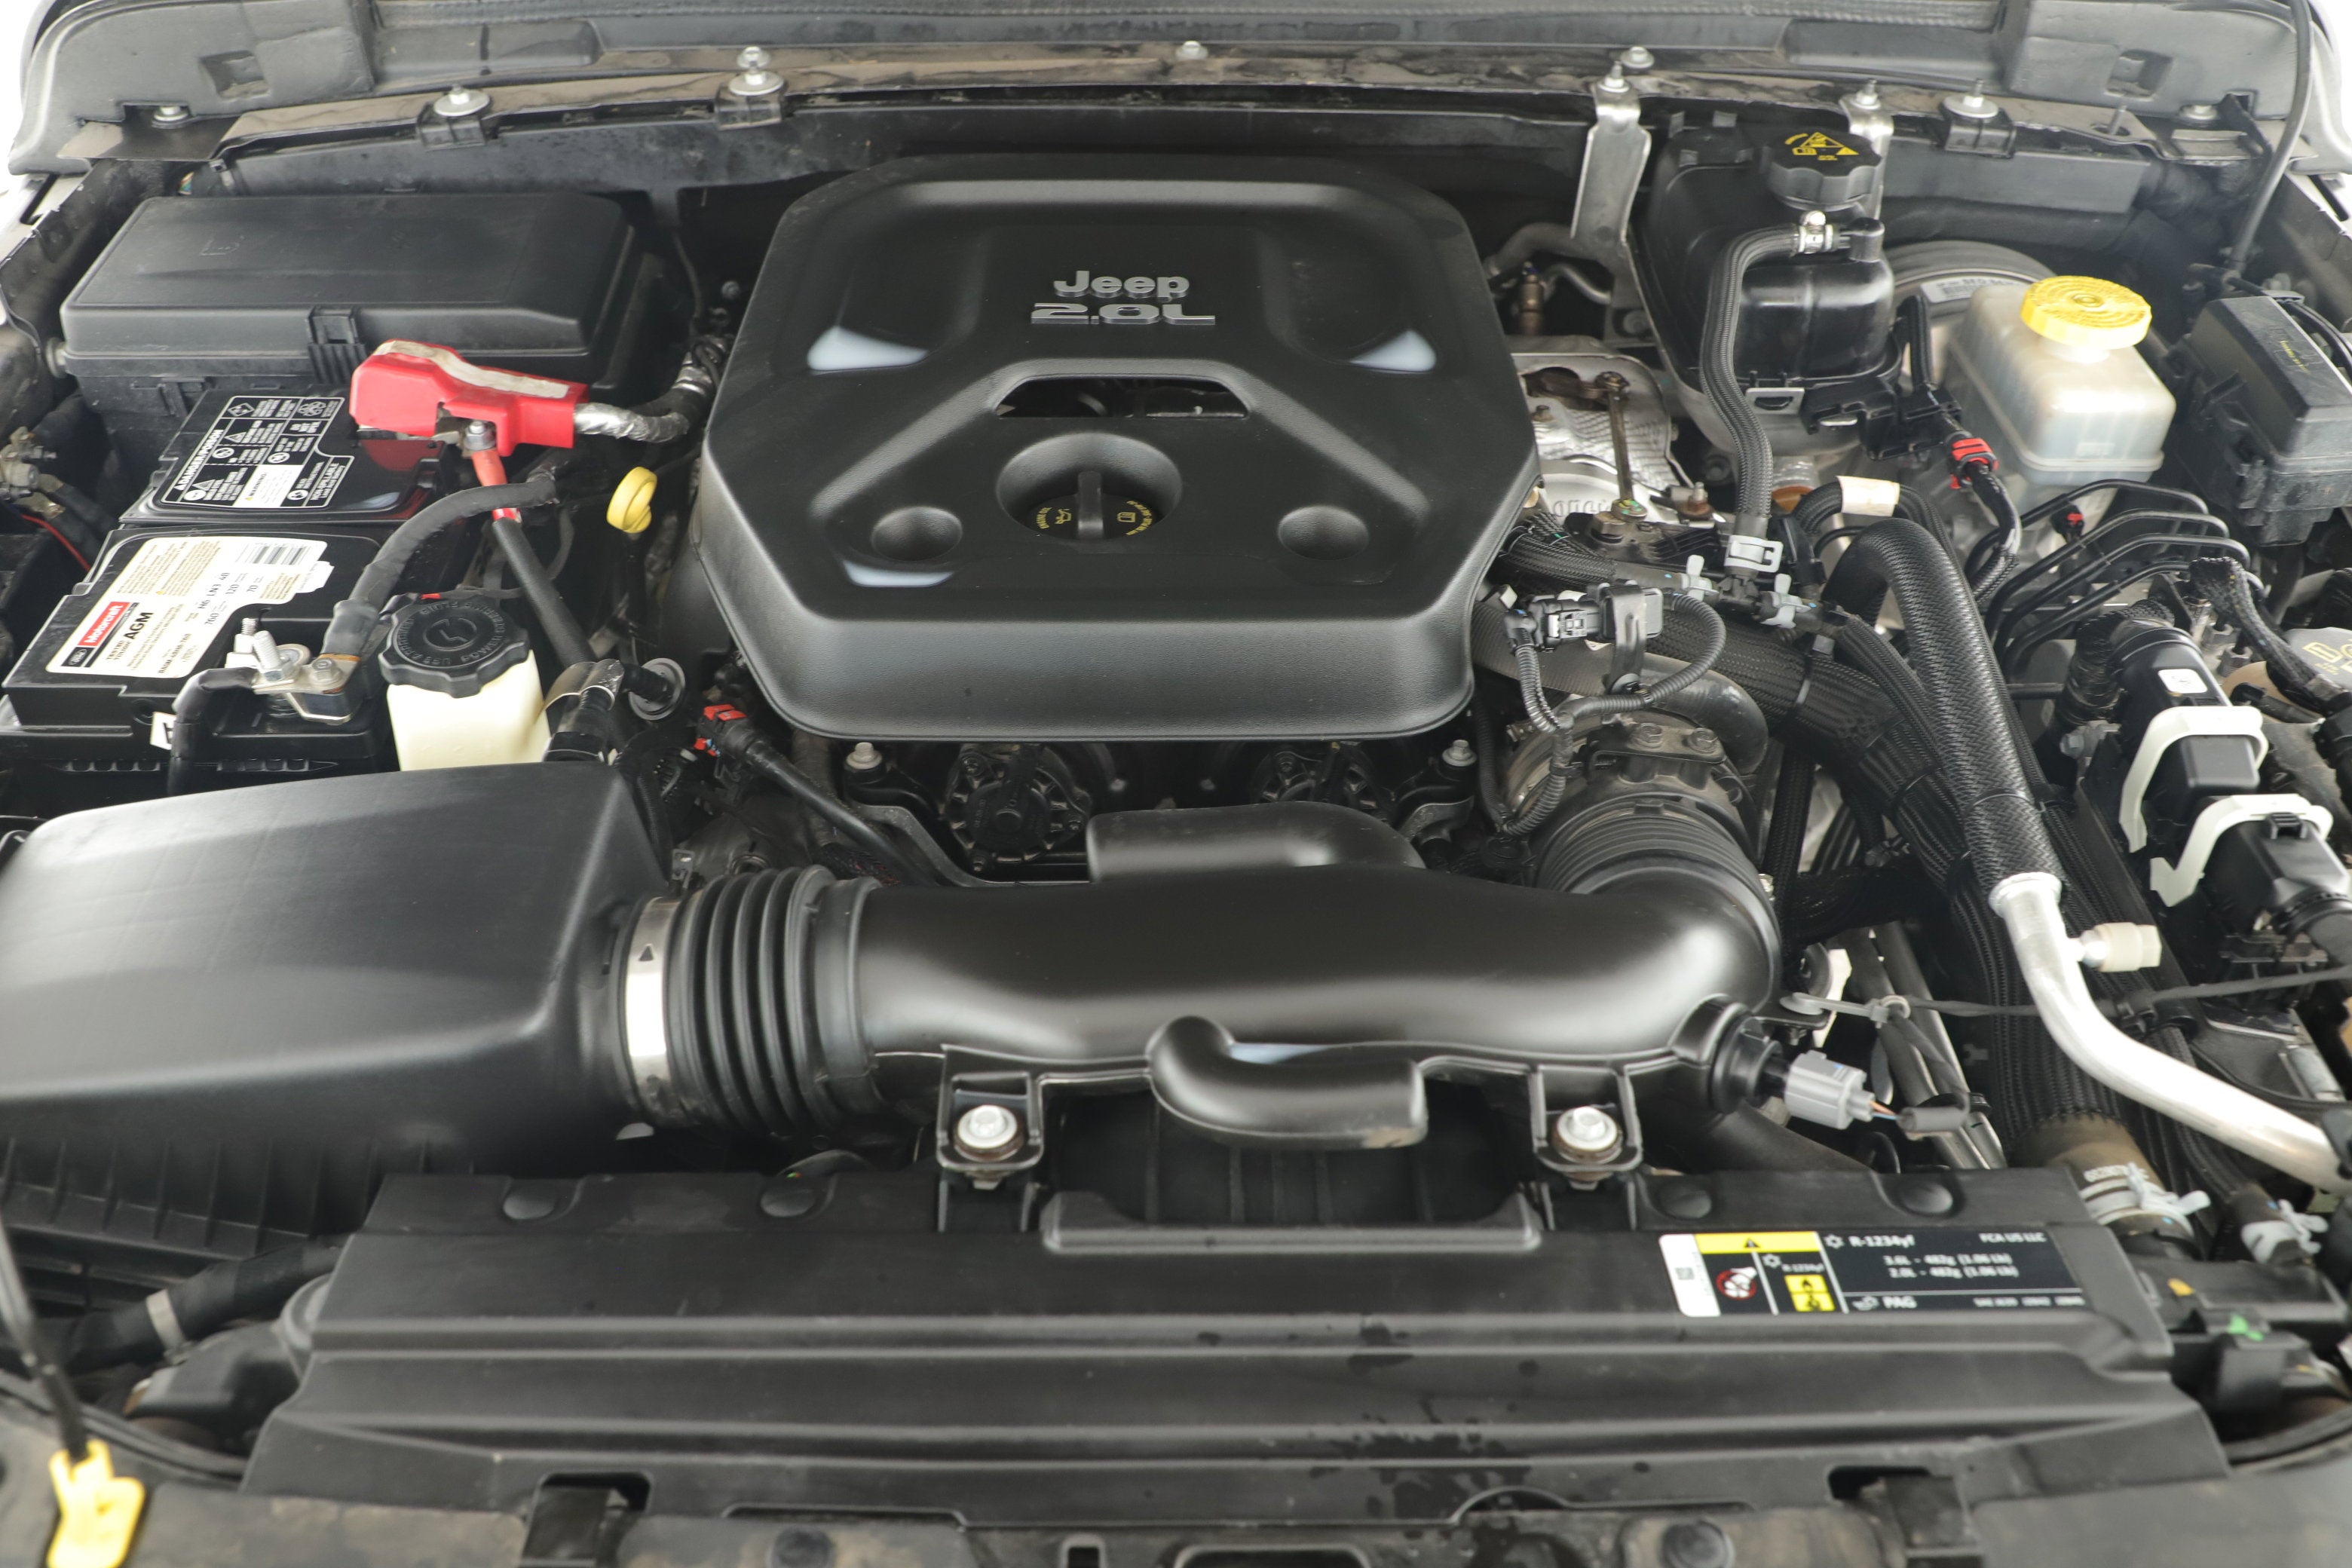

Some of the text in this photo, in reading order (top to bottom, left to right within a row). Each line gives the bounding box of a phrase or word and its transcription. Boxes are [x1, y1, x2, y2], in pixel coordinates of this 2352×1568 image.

[1054, 271, 1190, 302] Jeep
[1031, 303, 1215, 325] 2.0L
[225, 584, 240, 594] 120
[84, 605, 124, 643] Motorcraft
[124, 612, 154, 639] AGM
[204, 613, 219, 625] 760
[1848, 1234, 1916, 1248] R-1234yf
[1978, 1233, 2005, 1242] FCA
[1882, 1295, 1917, 1309] PAG
